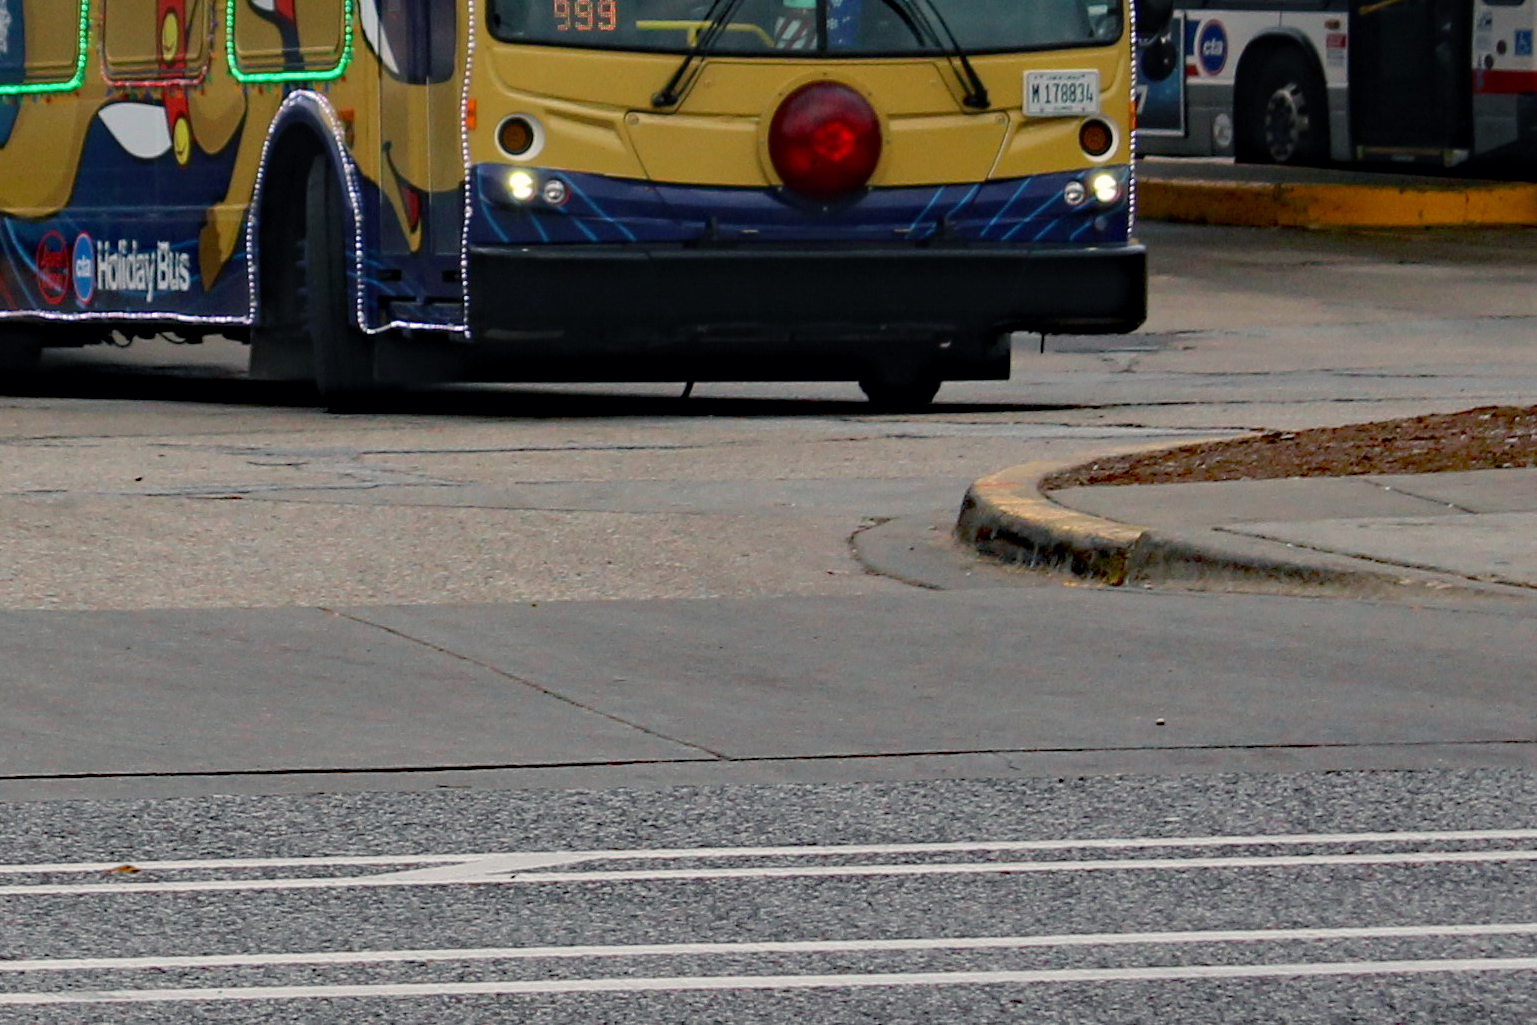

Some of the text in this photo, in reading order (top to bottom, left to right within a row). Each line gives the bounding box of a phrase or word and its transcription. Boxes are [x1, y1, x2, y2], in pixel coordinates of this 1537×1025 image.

[1203, 39, 1222, 55] cta
[97, 239, 155, 302] Holiday
[157, 240, 190, 291] Bus
